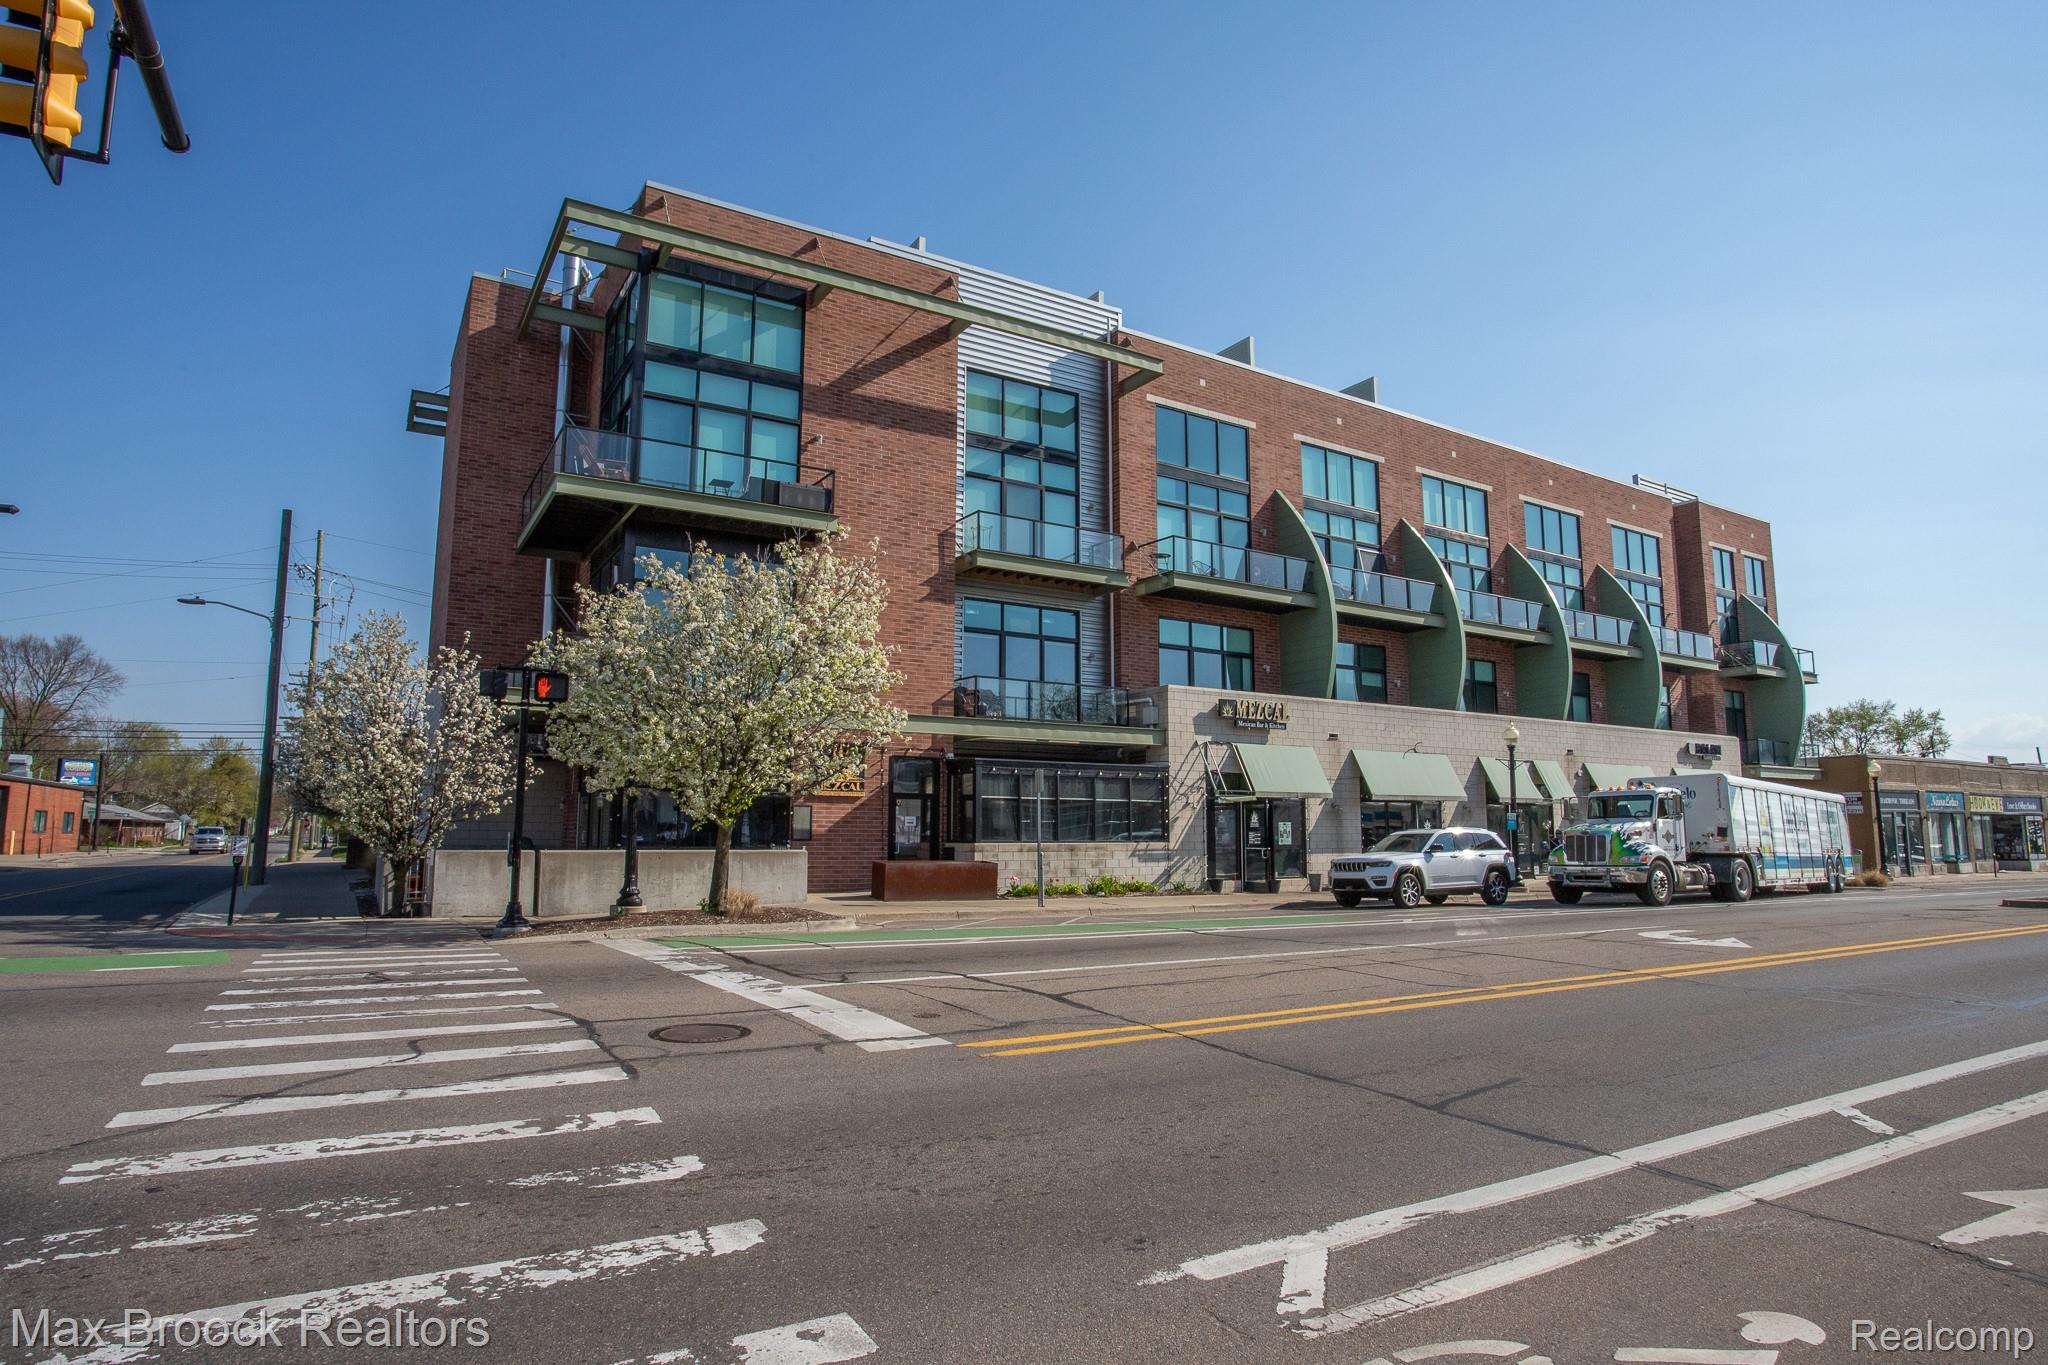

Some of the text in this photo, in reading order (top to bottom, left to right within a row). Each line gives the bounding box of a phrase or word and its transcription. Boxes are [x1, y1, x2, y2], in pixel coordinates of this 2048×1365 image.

[1236, 699, 1289, 720] MEZCAL
[1238, 720, 1256, 728] Mexican
[820, 781, 864, 791] EZCAL
